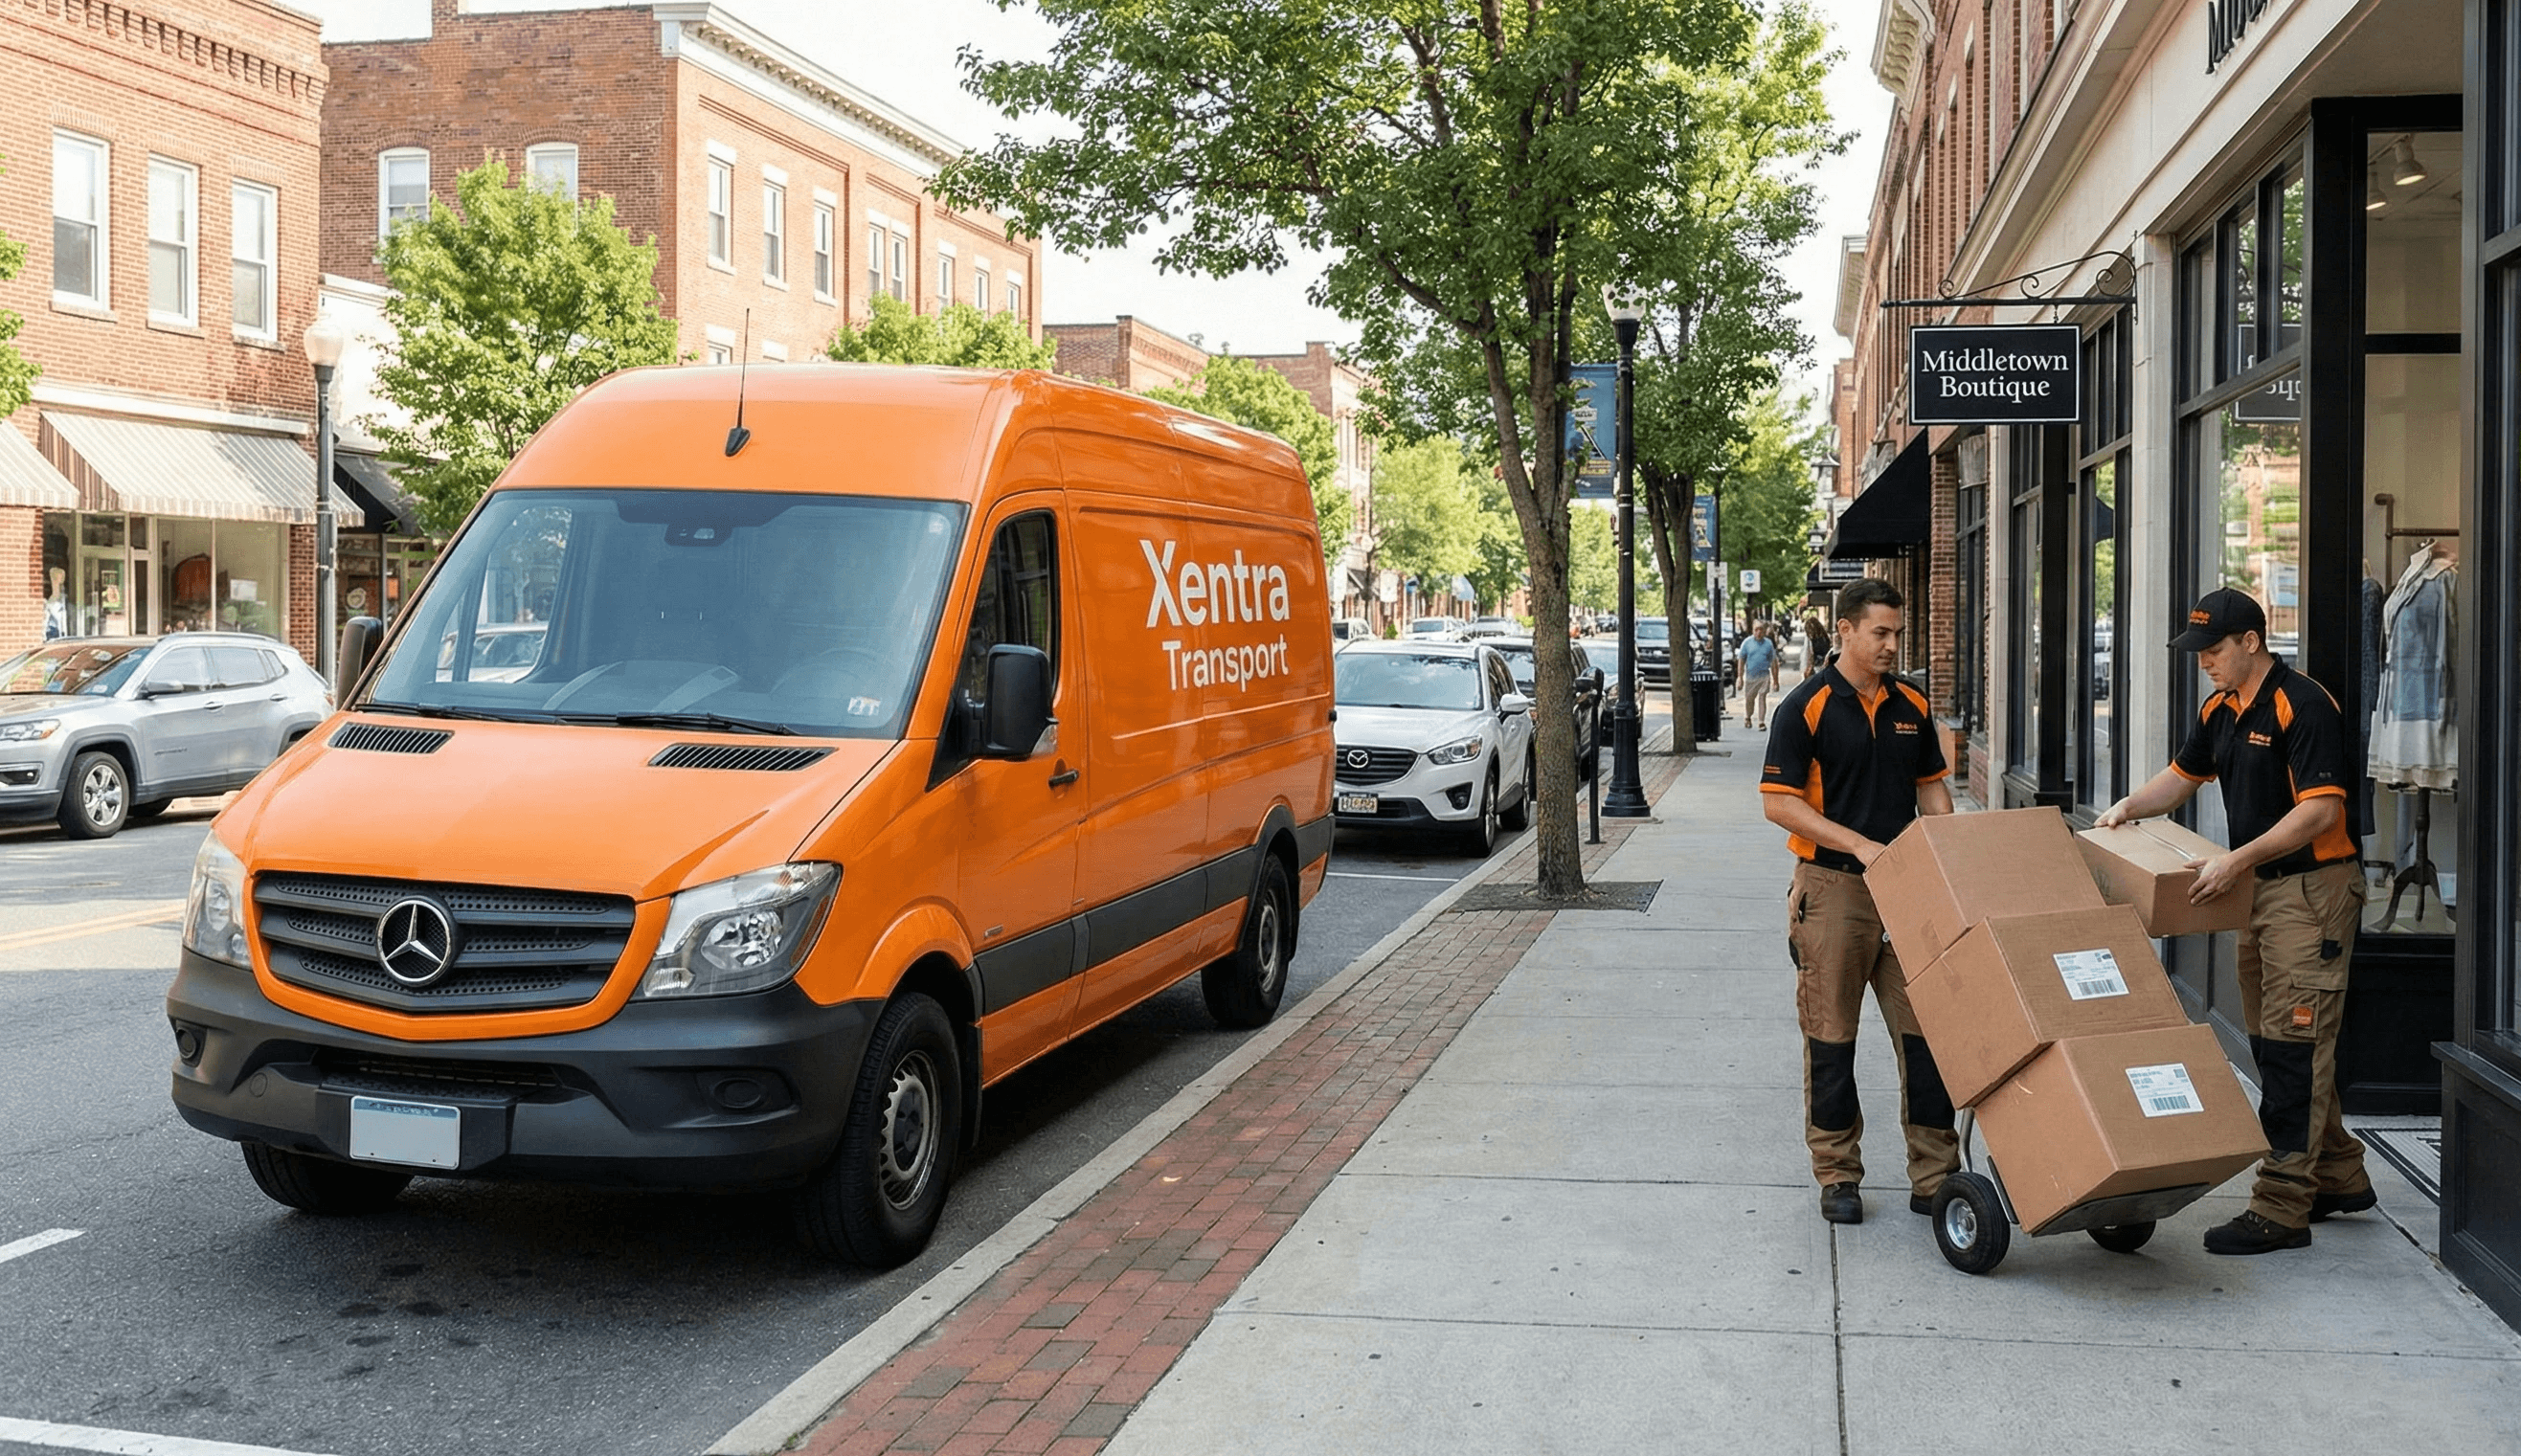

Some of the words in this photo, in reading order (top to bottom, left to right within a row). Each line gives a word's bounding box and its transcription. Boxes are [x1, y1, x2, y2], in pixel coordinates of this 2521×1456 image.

[1922, 347, 2069, 372] Middletown
[1940, 375, 2051, 404] Boutique
[1139, 539, 1290, 628] Xentra
[1162, 633, 1289, 692] Transport
